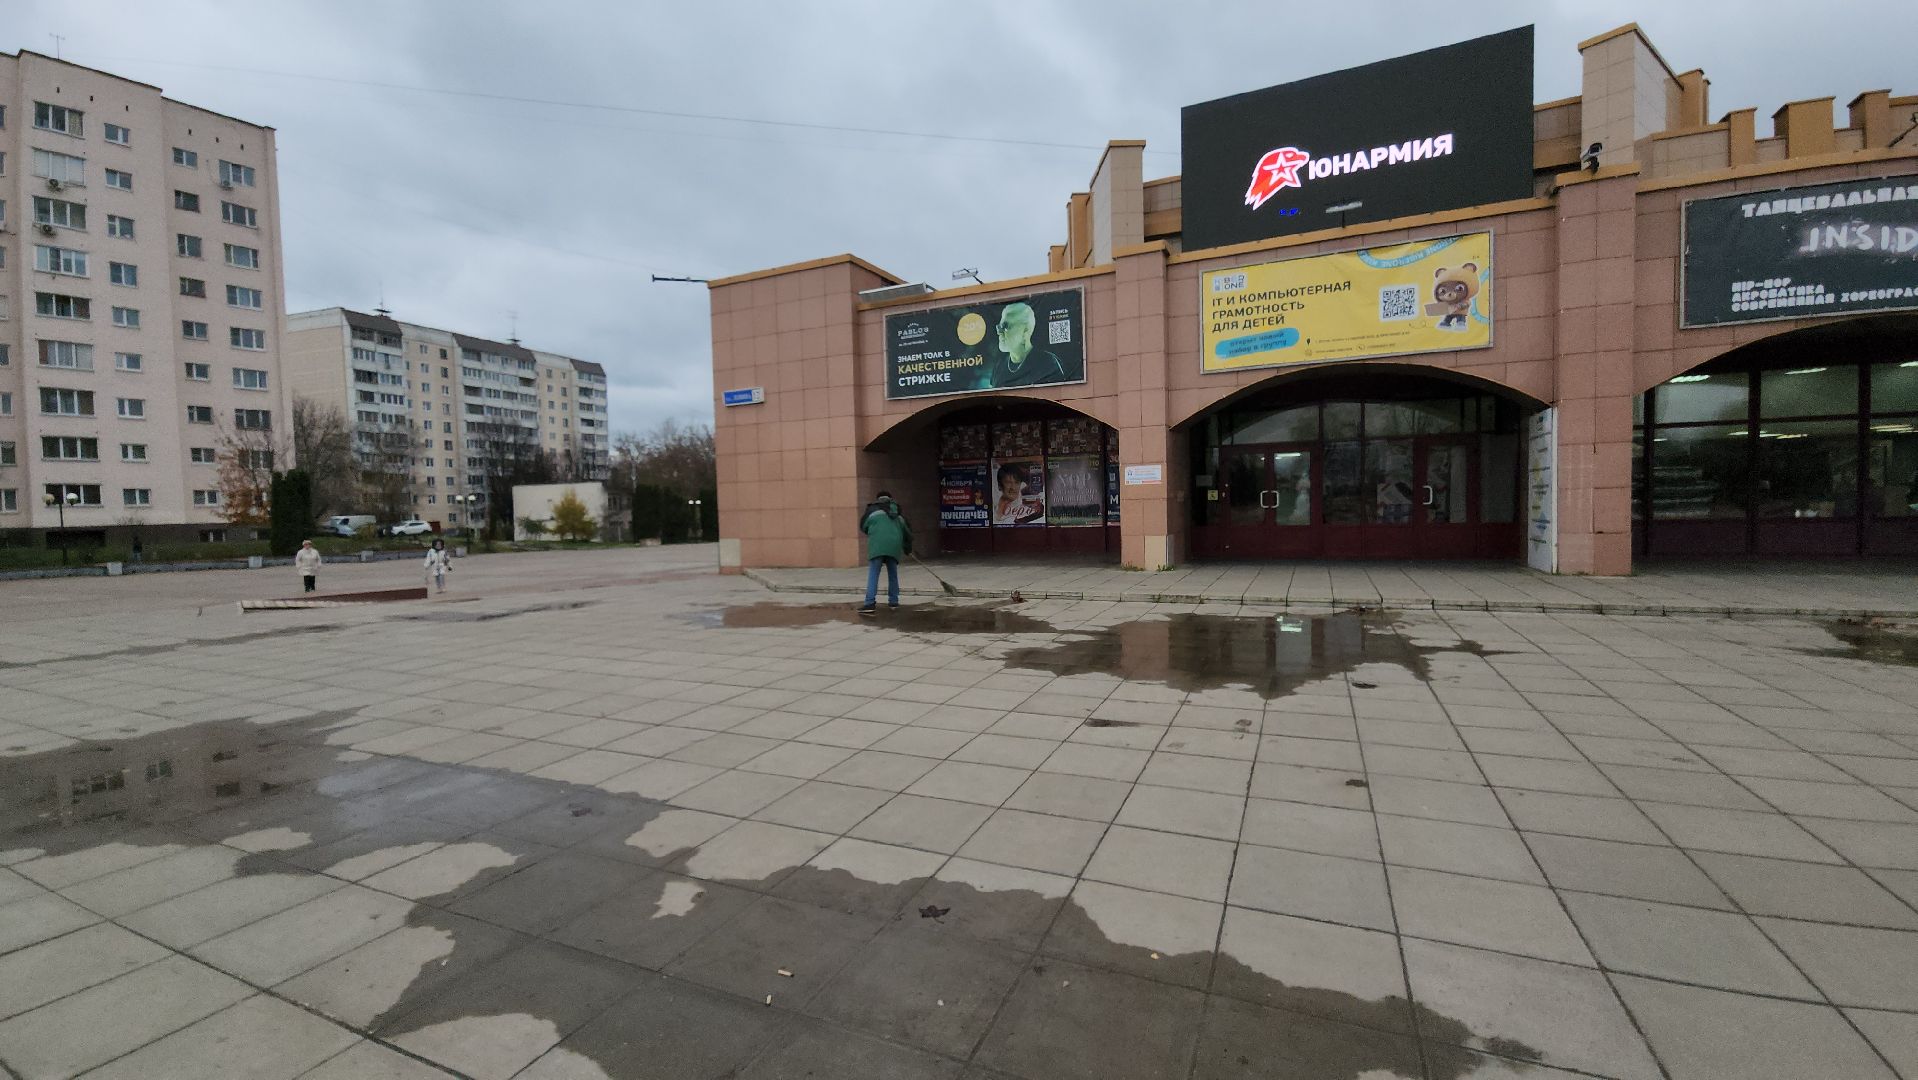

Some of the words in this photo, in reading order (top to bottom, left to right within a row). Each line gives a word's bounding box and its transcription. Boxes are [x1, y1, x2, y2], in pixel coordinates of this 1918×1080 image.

[1308, 133, 1453, 180] ЮНАРМИЯ
[1741, 185, 1918, 218] ТАНЦЕВАЛЬНАЯ
[1226, 295, 1235, 305] И
[1239, 280, 1351, 304] КОМПЬЮТЕРНАЯ
[1731, 277, 1792, 292] HIP-HOP
[1731, 284, 1825, 302] АКРОБАТИКА
[1212, 301, 1305, 319] ГРАМОТНОСТЬ
[1731, 292, 1835, 312] СОВРЕМЕННАЯ
[1212, 320, 1239, 333] ДЛЯ
[1242, 313, 1285, 330] ДЕТЕЙ
[898, 353, 922, 363] ЗНАЕМ
[923, 351, 943, 360] ТОЛК
[898, 354, 983, 374] КАЧЕСТВЕННОЙ
[898, 373, 951, 386] СТРИЖКЕ
